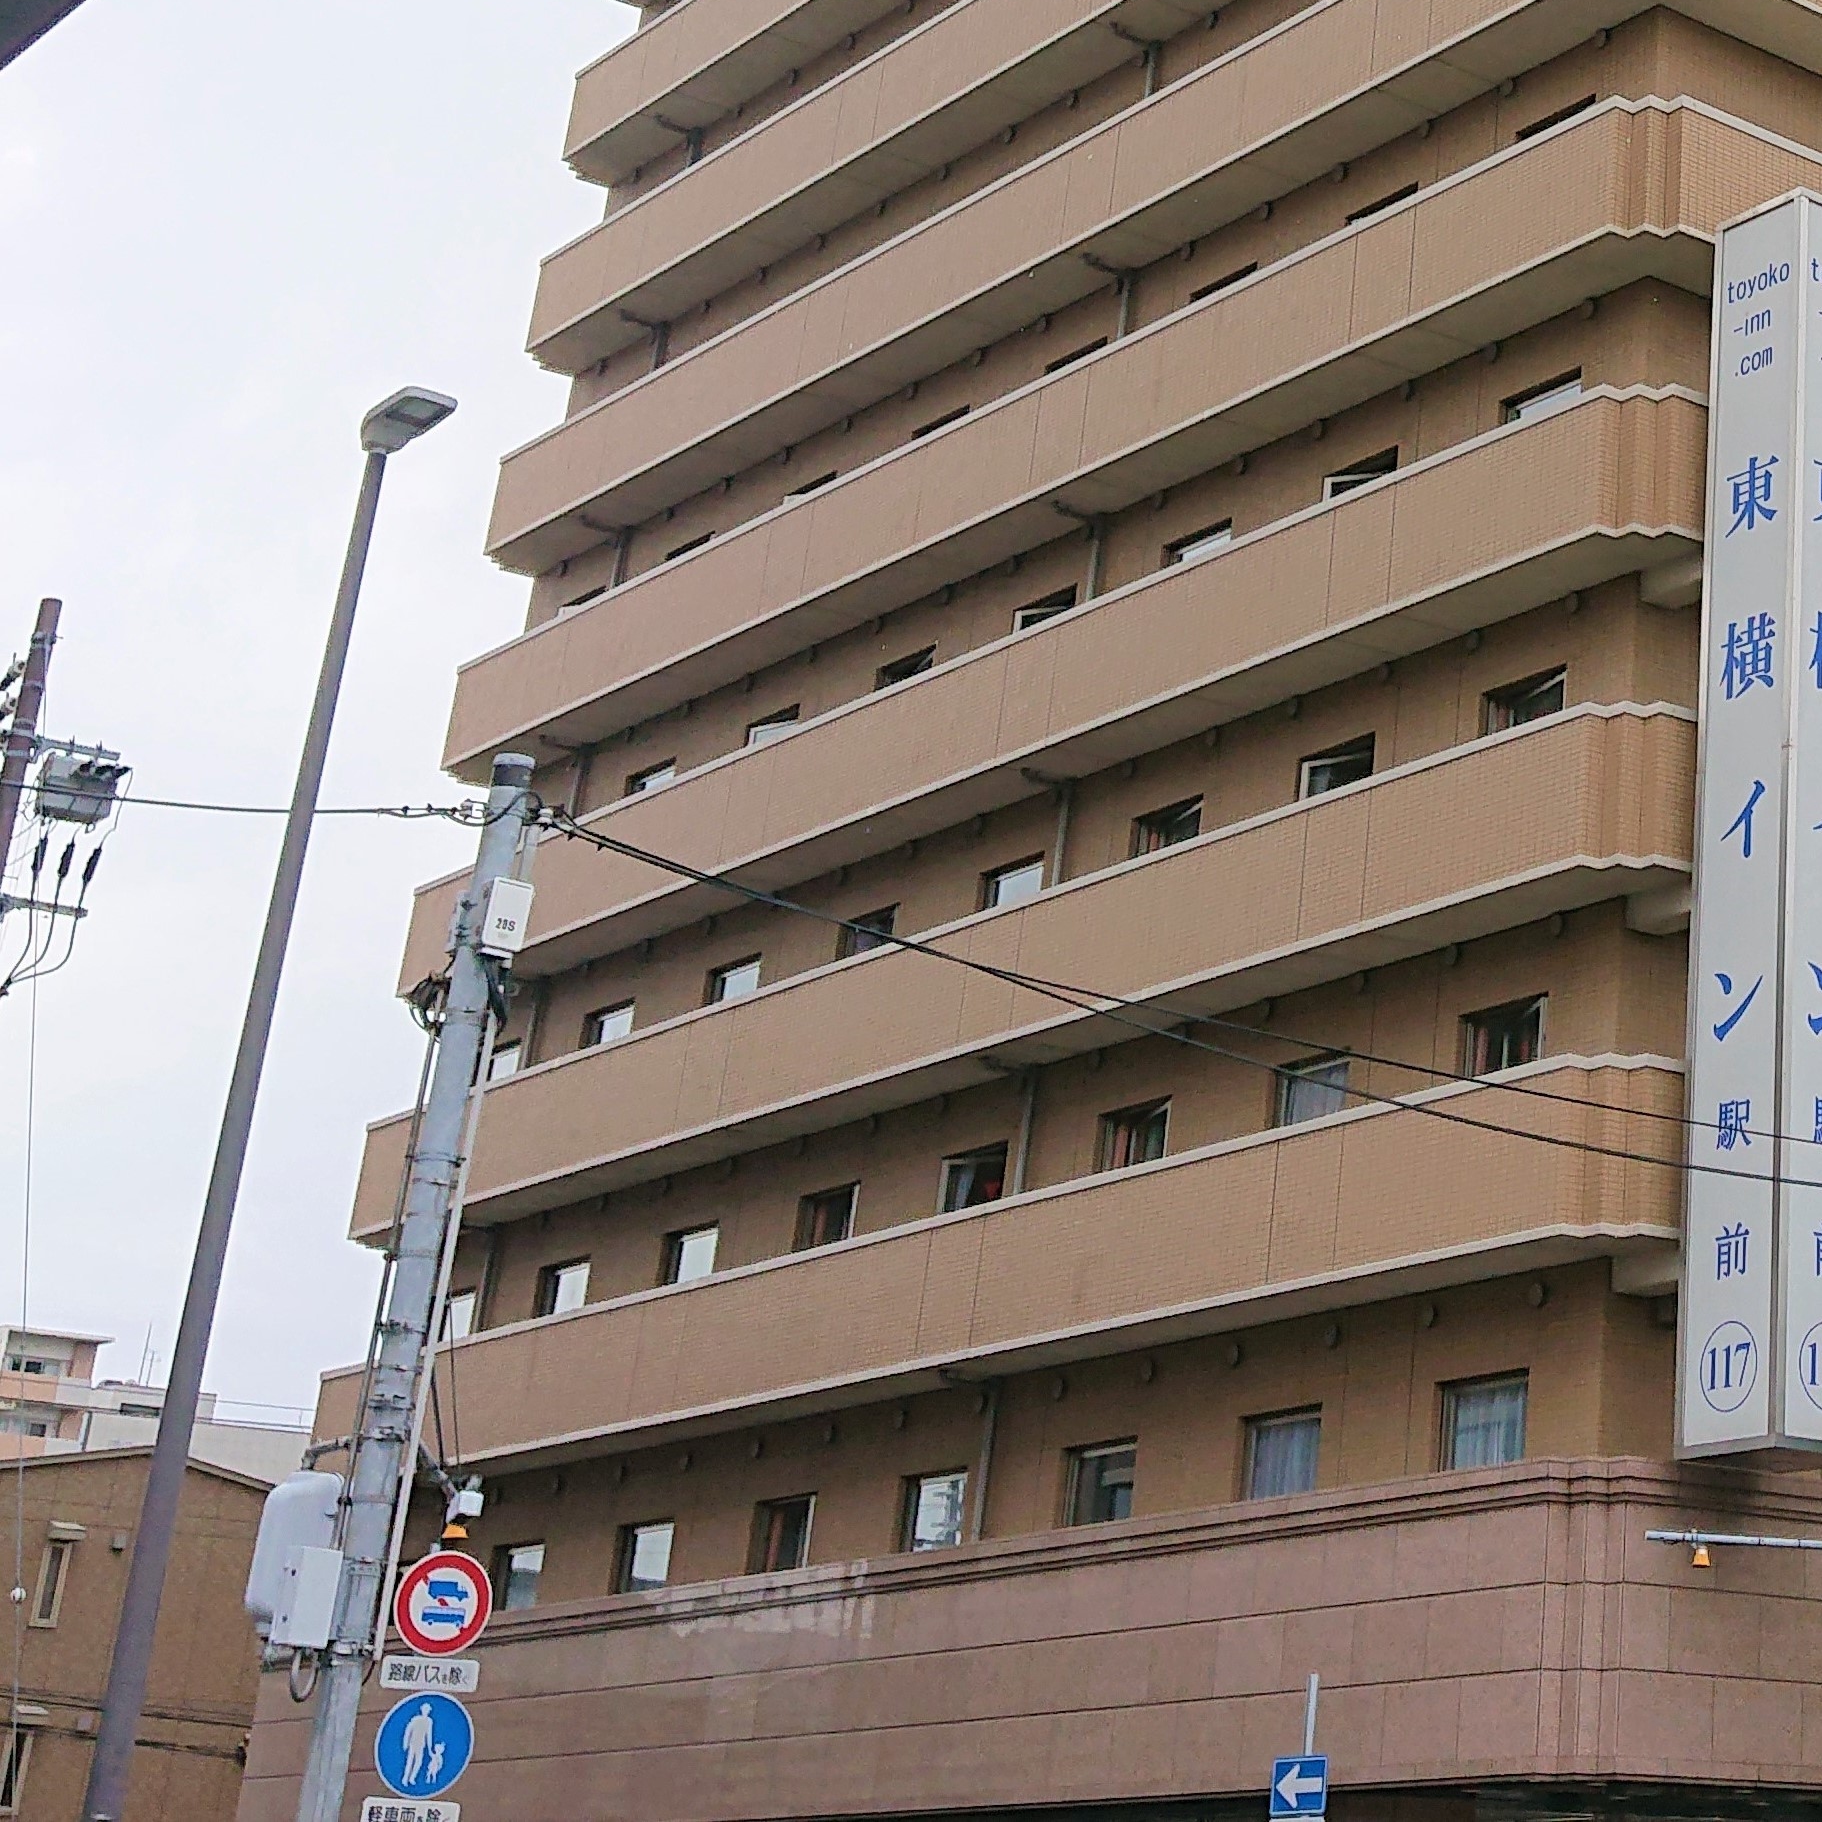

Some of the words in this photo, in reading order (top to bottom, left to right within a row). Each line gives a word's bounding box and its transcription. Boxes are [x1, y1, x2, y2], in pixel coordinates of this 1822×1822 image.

[1727, 262, 1790, 304] toyoko
[1733, 308, 1771, 337] -inn
[1734, 346, 1773, 377] .com
[1706, 1340, 1751, 1392] 117
[387, 1662, 468, 1685] 路線バスを除く
